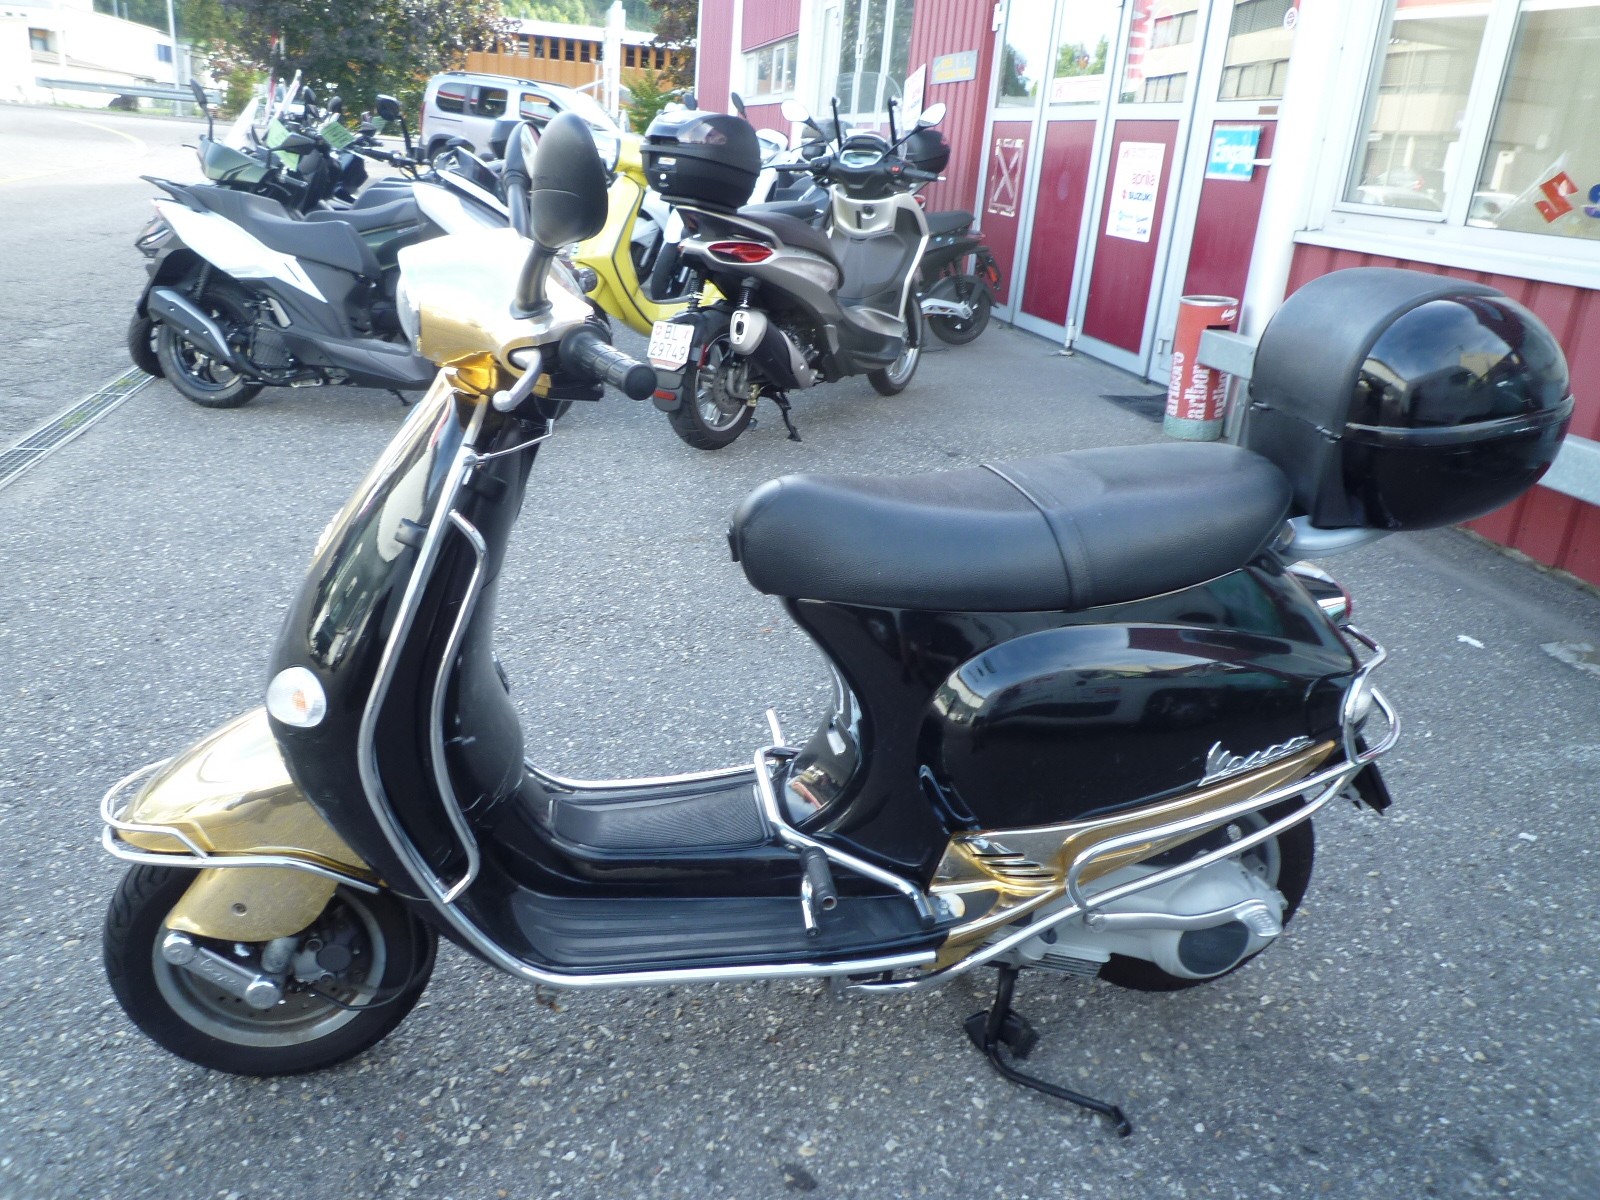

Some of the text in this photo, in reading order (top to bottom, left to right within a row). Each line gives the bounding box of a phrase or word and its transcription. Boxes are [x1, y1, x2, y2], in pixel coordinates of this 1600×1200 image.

[664, 324, 678, 340] BL
[650, 341, 686, 360] 29749
[1184, 363, 1210, 420] arlbor
